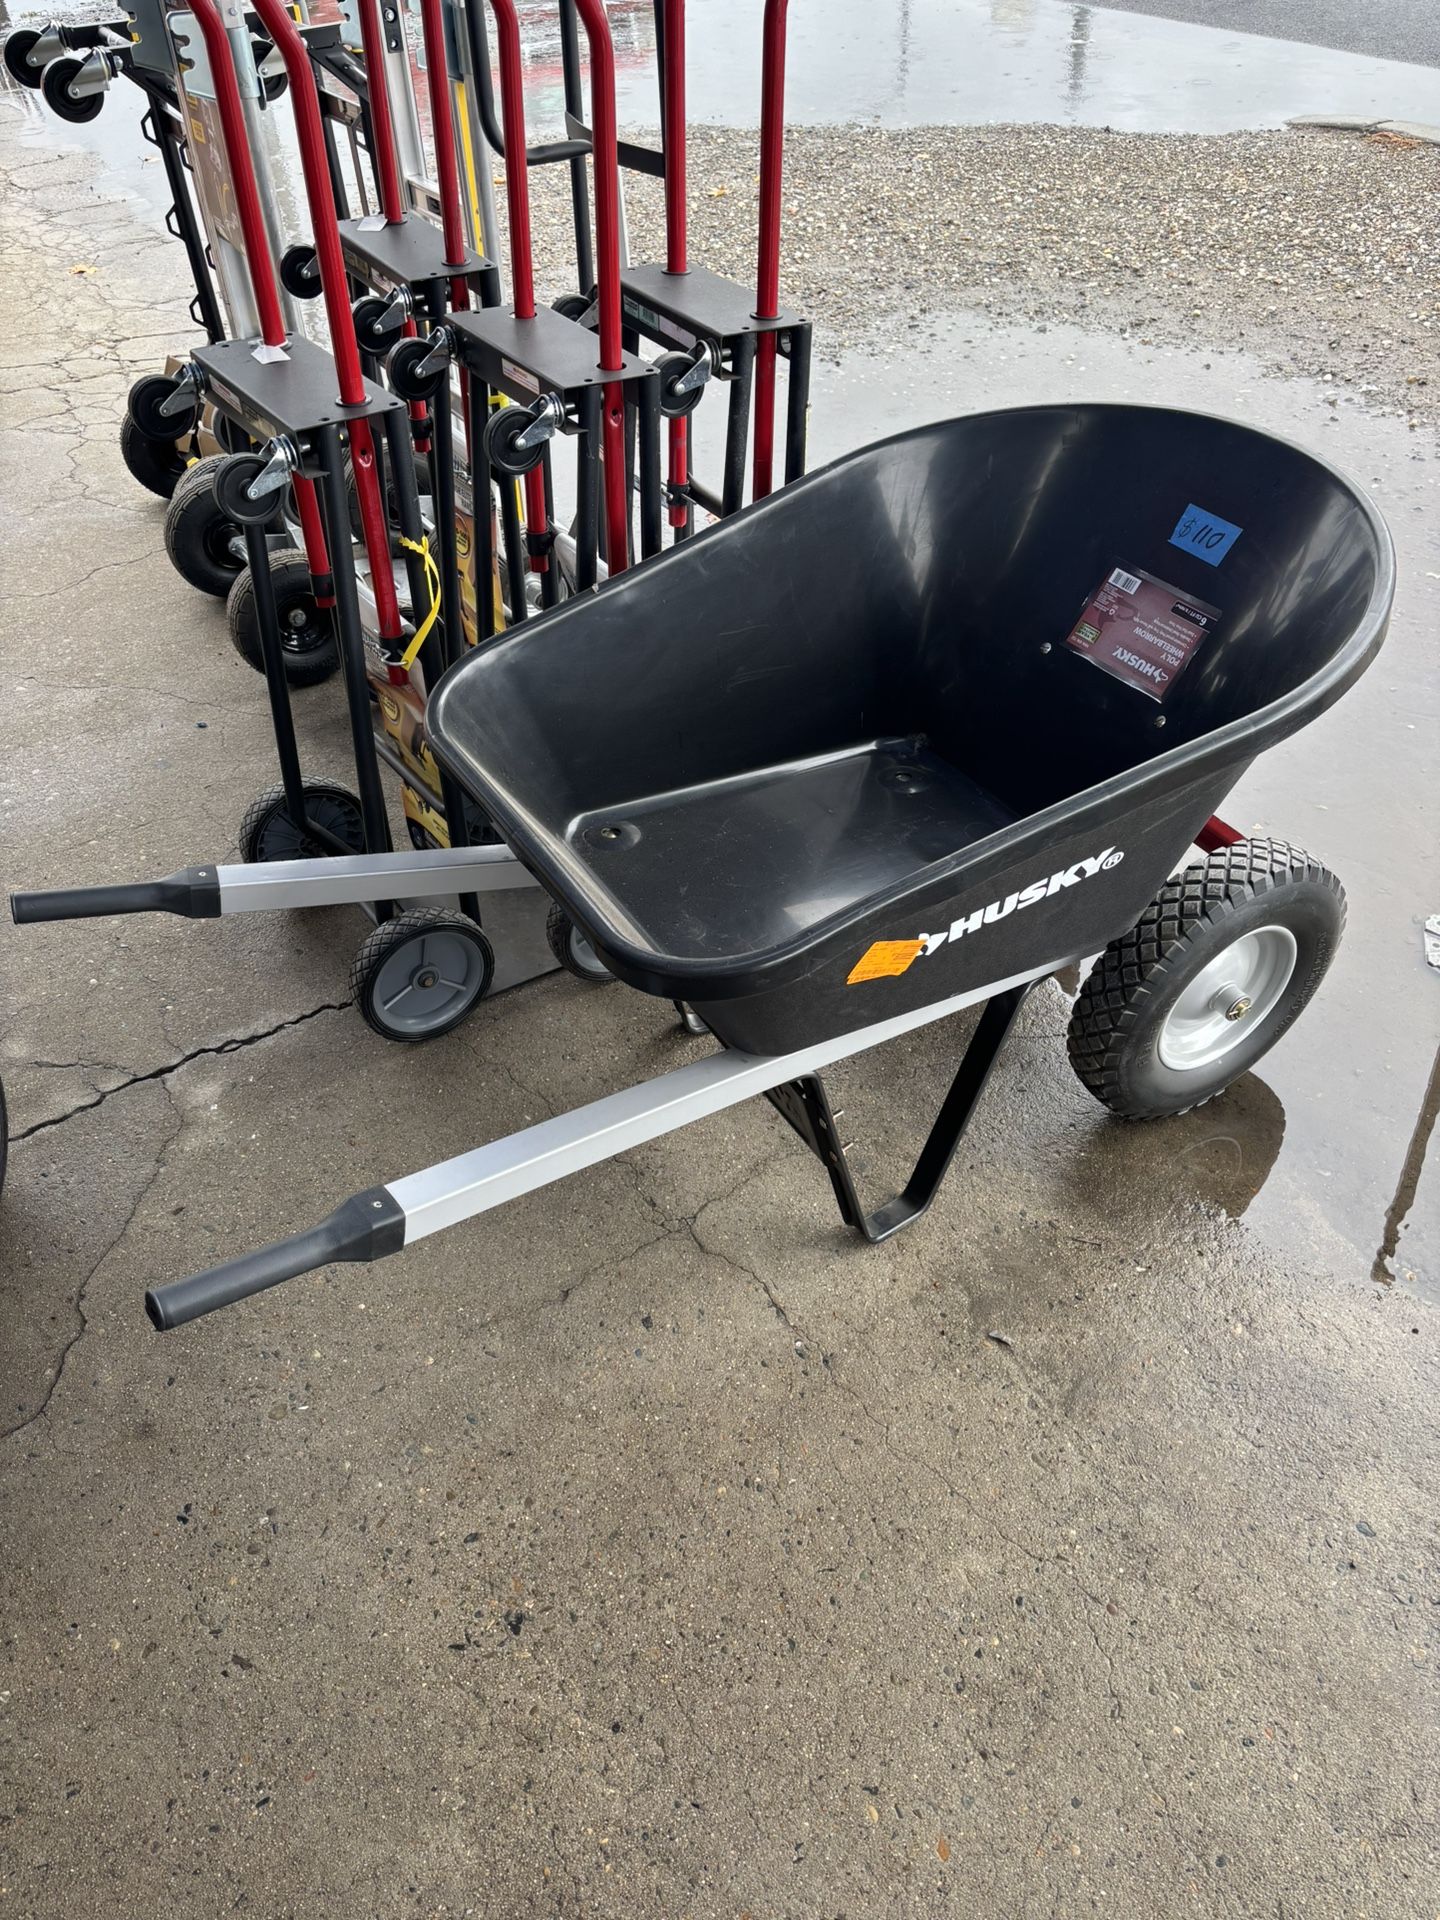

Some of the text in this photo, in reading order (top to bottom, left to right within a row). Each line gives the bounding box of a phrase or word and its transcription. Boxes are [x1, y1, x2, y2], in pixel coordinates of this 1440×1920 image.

[1177, 518, 1226, 549] $110
[1198, 617, 1208, 626] 6
[1133, 626, 1186, 658] WHEELBARROW
[1112, 646, 1156, 676] HUSKY
[1160, 651, 1180, 666] POLY
